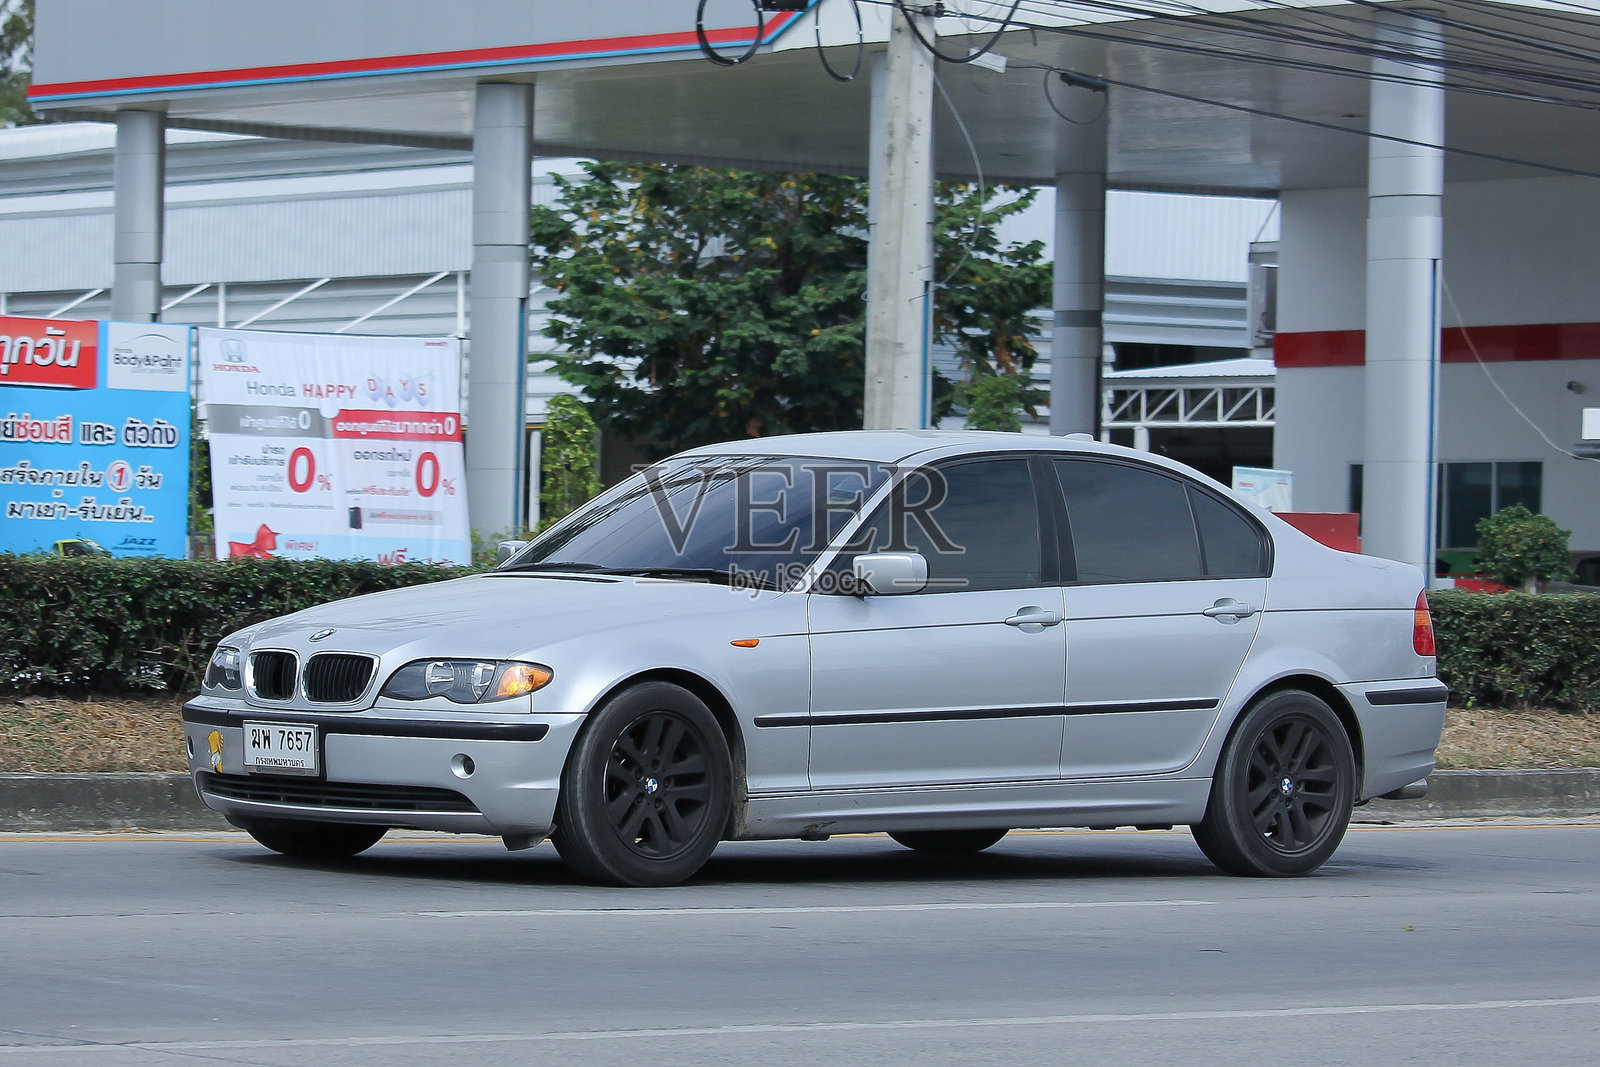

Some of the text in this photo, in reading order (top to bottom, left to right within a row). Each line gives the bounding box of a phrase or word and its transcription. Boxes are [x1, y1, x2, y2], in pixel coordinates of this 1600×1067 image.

[212, 364, 261, 373] HONDA
[246, 378, 427, 399] Honda HAPPY DAYS
[82, 423, 114, 442] และ
[125, 419, 176, 444] ตัวถัง
[1, 462, 104, 486] สร็จภายใน
[135, 466, 162, 488] วัน
[278, 729, 312, 752] 7657
[255, 756, 305, 767] กรงเทพมหานคร
